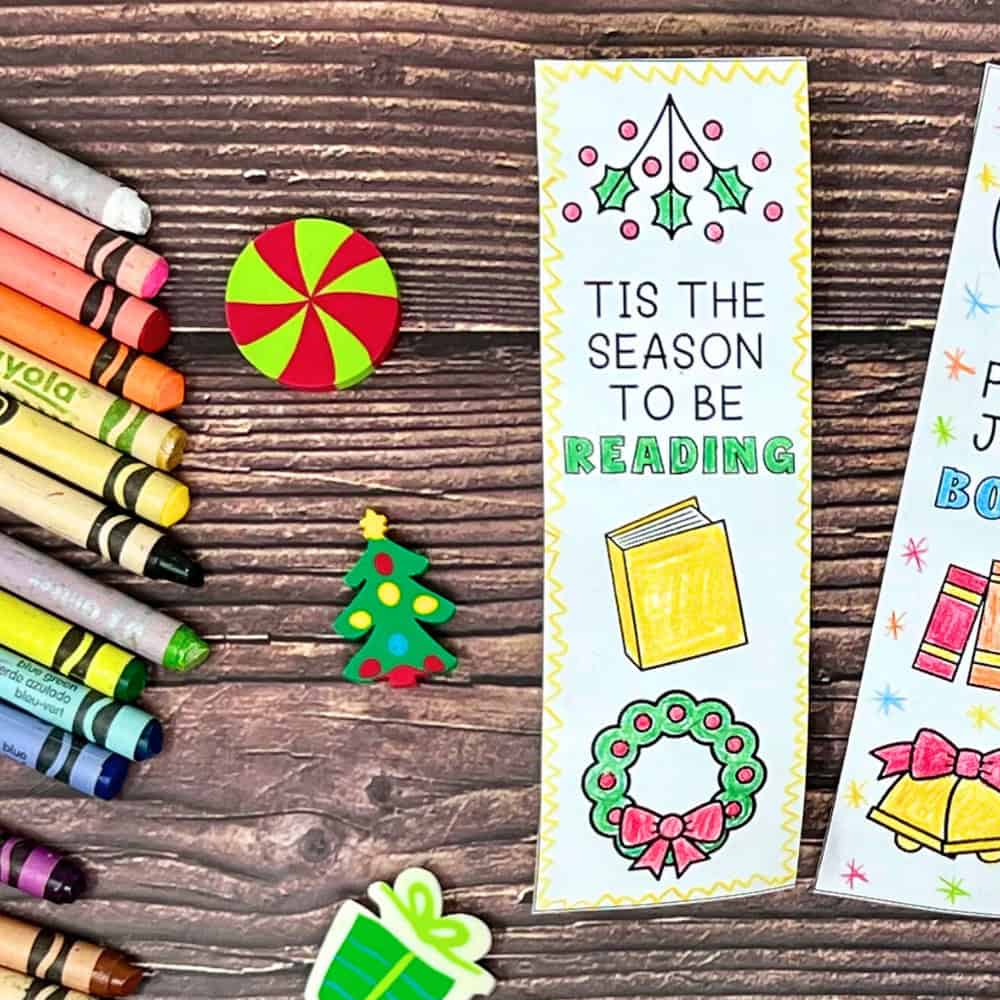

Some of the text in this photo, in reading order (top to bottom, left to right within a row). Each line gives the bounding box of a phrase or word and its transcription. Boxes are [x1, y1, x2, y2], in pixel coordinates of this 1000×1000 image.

[583, 280, 766, 319] TIS THE
[587, 332, 763, 370] SEASON
[0, 351, 78, 404] yola
[608, 384, 744, 422] TO BE
[562, 434, 796, 476] READING
[0, 665, 24, 683] erde
